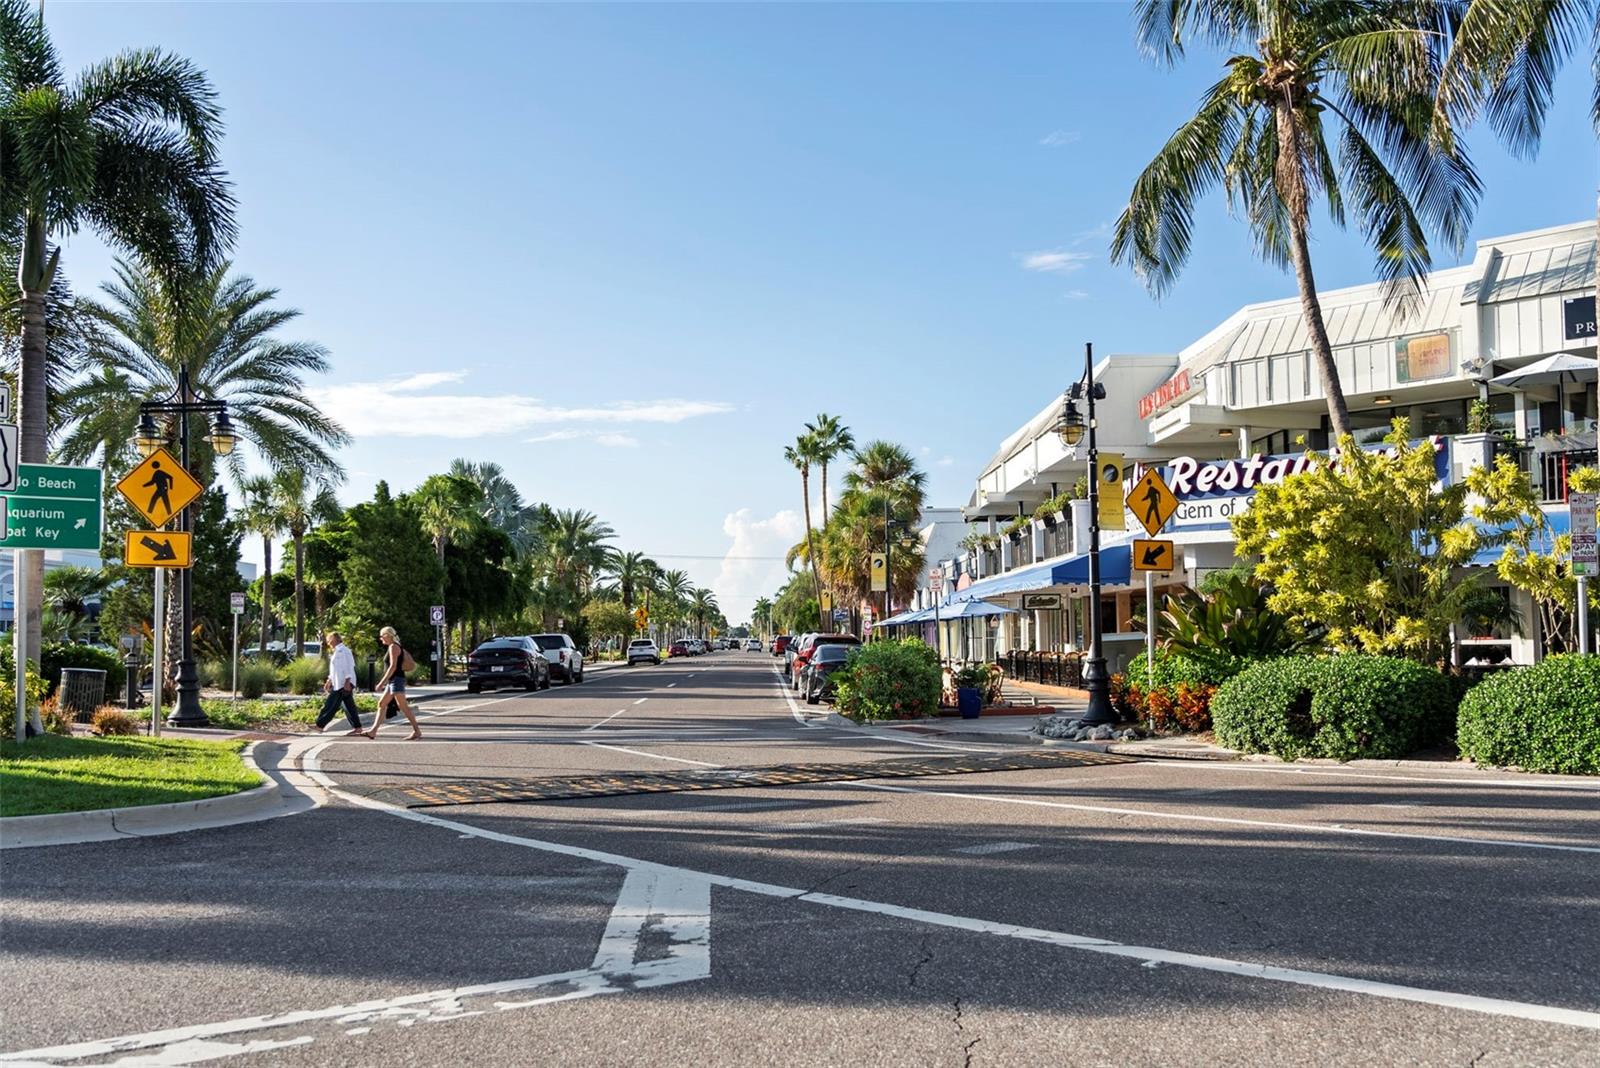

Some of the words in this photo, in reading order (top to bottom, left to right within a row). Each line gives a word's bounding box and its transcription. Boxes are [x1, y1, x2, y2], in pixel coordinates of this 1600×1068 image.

[38, 476, 76, 489] Beach
[1175, 502, 1213, 520] Gem
[1220, 497, 1237, 517] of
[35, 526, 60, 541] Key
